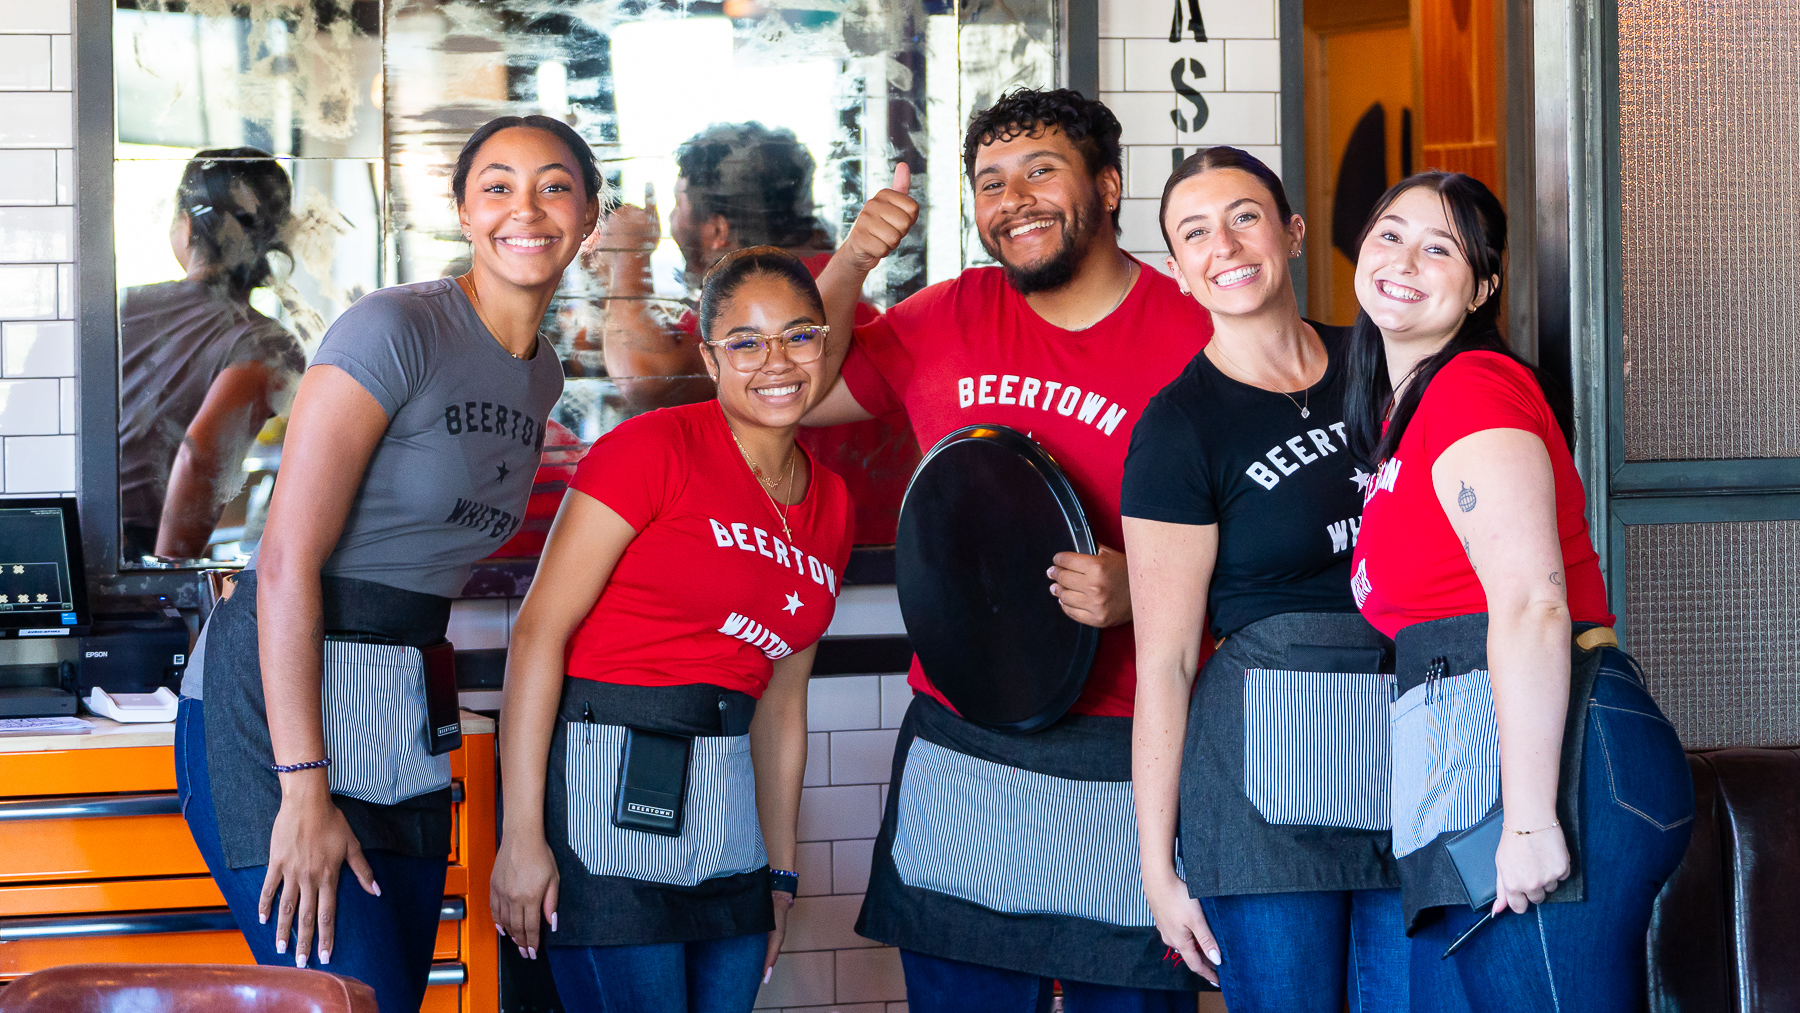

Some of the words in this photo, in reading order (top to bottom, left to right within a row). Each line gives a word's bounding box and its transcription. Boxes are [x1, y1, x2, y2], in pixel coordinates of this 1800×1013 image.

[445, 401, 545, 456] BEERTOW
[958, 374, 1127, 436] BEERTOWN
[1245, 421, 1348, 490] BEERT
[444, 497, 520, 542] WHITBY
[708, 518, 837, 598] BEERTOW
[717, 612, 793, 660] WHITBY
[631, 805, 671, 816] BEERTOWN
